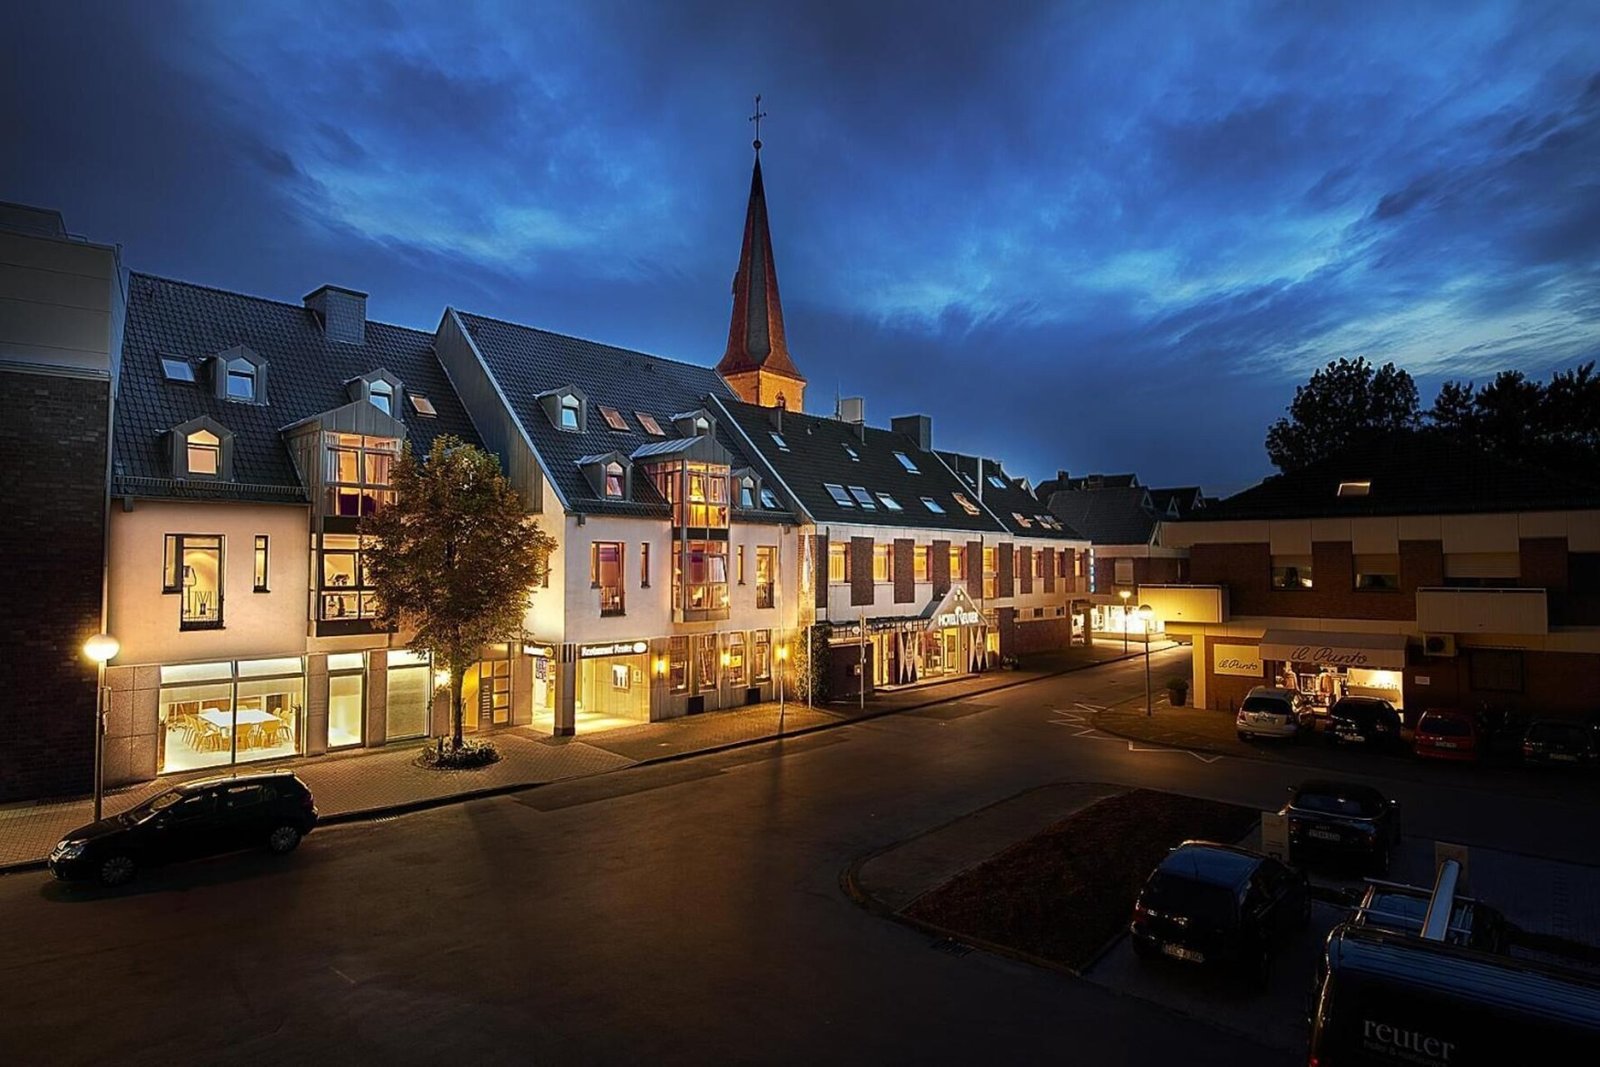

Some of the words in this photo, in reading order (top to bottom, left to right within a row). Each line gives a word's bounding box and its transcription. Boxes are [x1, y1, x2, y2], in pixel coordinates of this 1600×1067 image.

[1313, 647, 1368, 664] Punto
[1229, 659, 1258, 670] Punto
[1363, 1019, 1456, 1060] reuter
